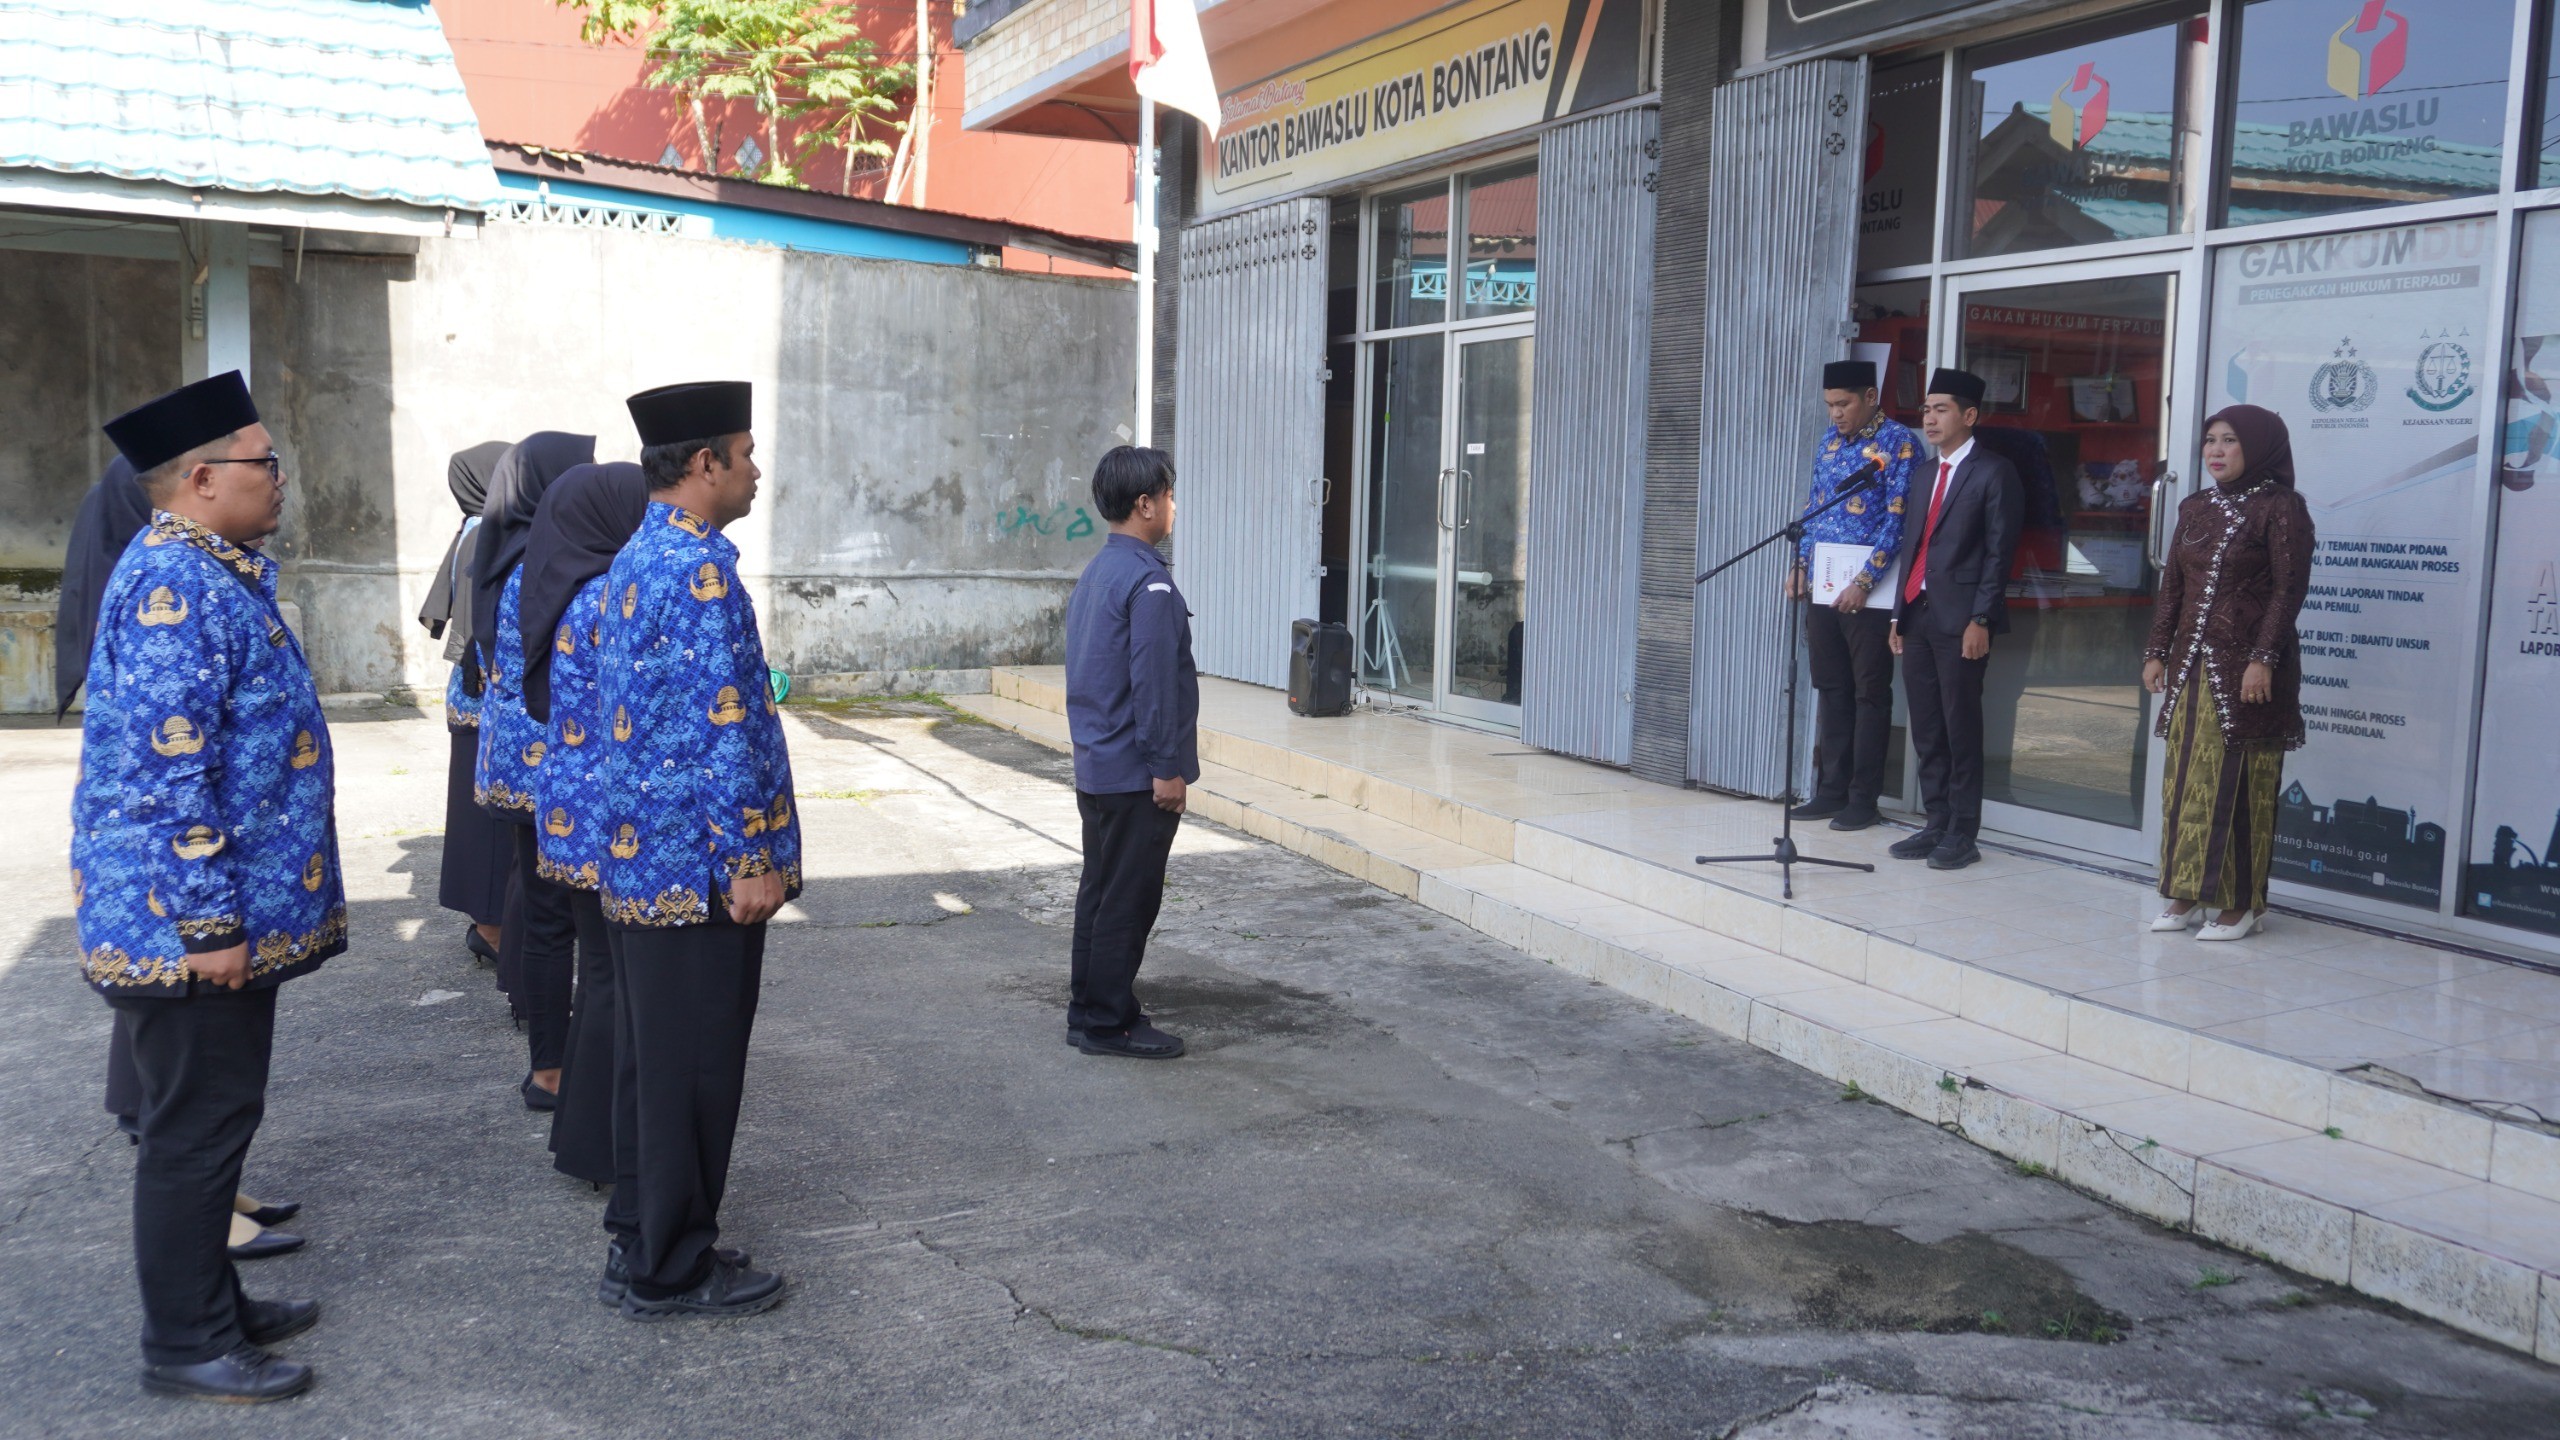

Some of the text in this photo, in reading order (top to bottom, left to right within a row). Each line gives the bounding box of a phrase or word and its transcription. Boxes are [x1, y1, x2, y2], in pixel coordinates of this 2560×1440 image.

[1220, 27, 1552, 178] KANTOR BAWASLU KOTA BONTANG
[1261, 80, 1305, 108] Datang
[2288, 97, 2439, 147] BAWASLU
[2286, 135, 2435, 173] KOTA BONTANG
[1861, 189, 1903, 214] ASLU
[1860, 217, 1901, 234] NTANG
[2239, 221, 2486, 279] GAKKUMDU
[2250, 272, 2461, 301] PENEGAKKAN HUKUM TERPADU
[2031, 312, 2087, 329] HUKUM
[2092, 318, 2162, 335] TERPADU
[2402, 418, 2444, 426] KEJAKSAAN
[2328, 541, 2367, 552] TEMUAN
[2370, 543, 2406, 554] TINDAK
[2409, 544, 2447, 556] PIDANA
[2325, 556, 2358, 567] DALAM
[2361, 558, 2418, 571] RANGKAIAN
[2421, 561, 2459, 573] PROSES
[2340, 587, 2384, 599] LAPORAN
[2387, 590, 2424, 602] TINDAK
[2302, 600, 2362, 613] ANA PEMILU.
[2299, 629, 2313, 639] LAT
[2317, 630, 2342, 642] BUKTI
[2351, 633, 2393, 647] DIBANTU
[2396, 637, 2430, 650] UNSUR
[2329, 647, 2357, 659] POLRI.
[2301, 674, 2350, 689] NGKAJIAN.
[2331, 707, 2367, 721] HINGGA
[2370, 712, 2406, 726] PROSES
[2309, 720, 2328, 732] DAN
[2331, 723, 2386, 739] PERADILAN.
